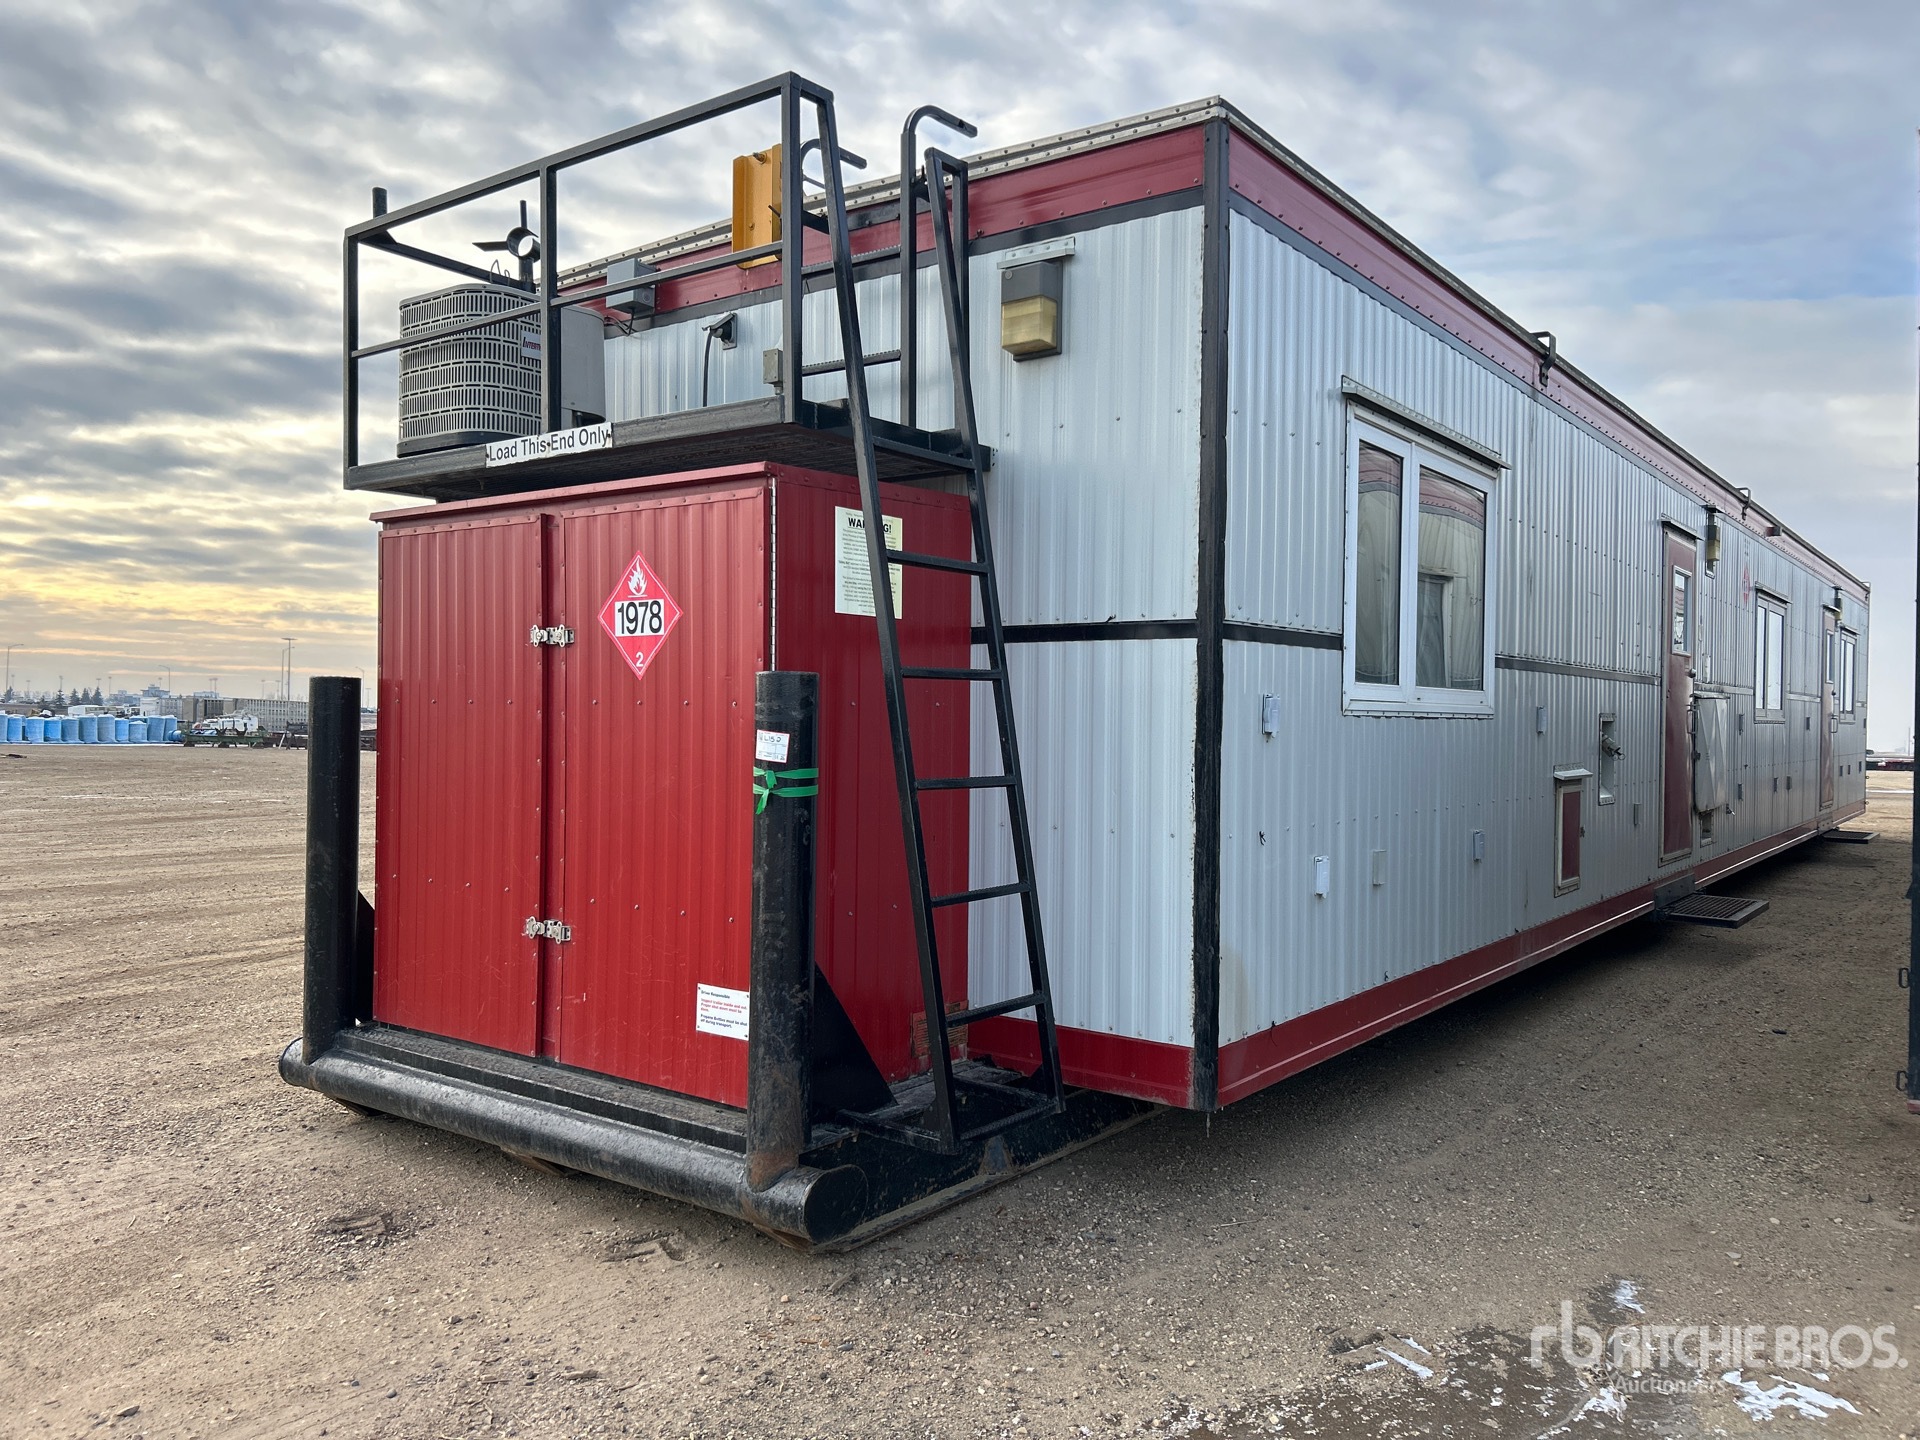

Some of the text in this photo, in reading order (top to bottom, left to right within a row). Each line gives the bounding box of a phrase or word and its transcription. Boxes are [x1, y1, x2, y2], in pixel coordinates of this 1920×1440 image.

[489, 426, 609, 461] Load This End Only
[617, 600, 663, 635] 1978
[635, 651, 644, 667] 2
